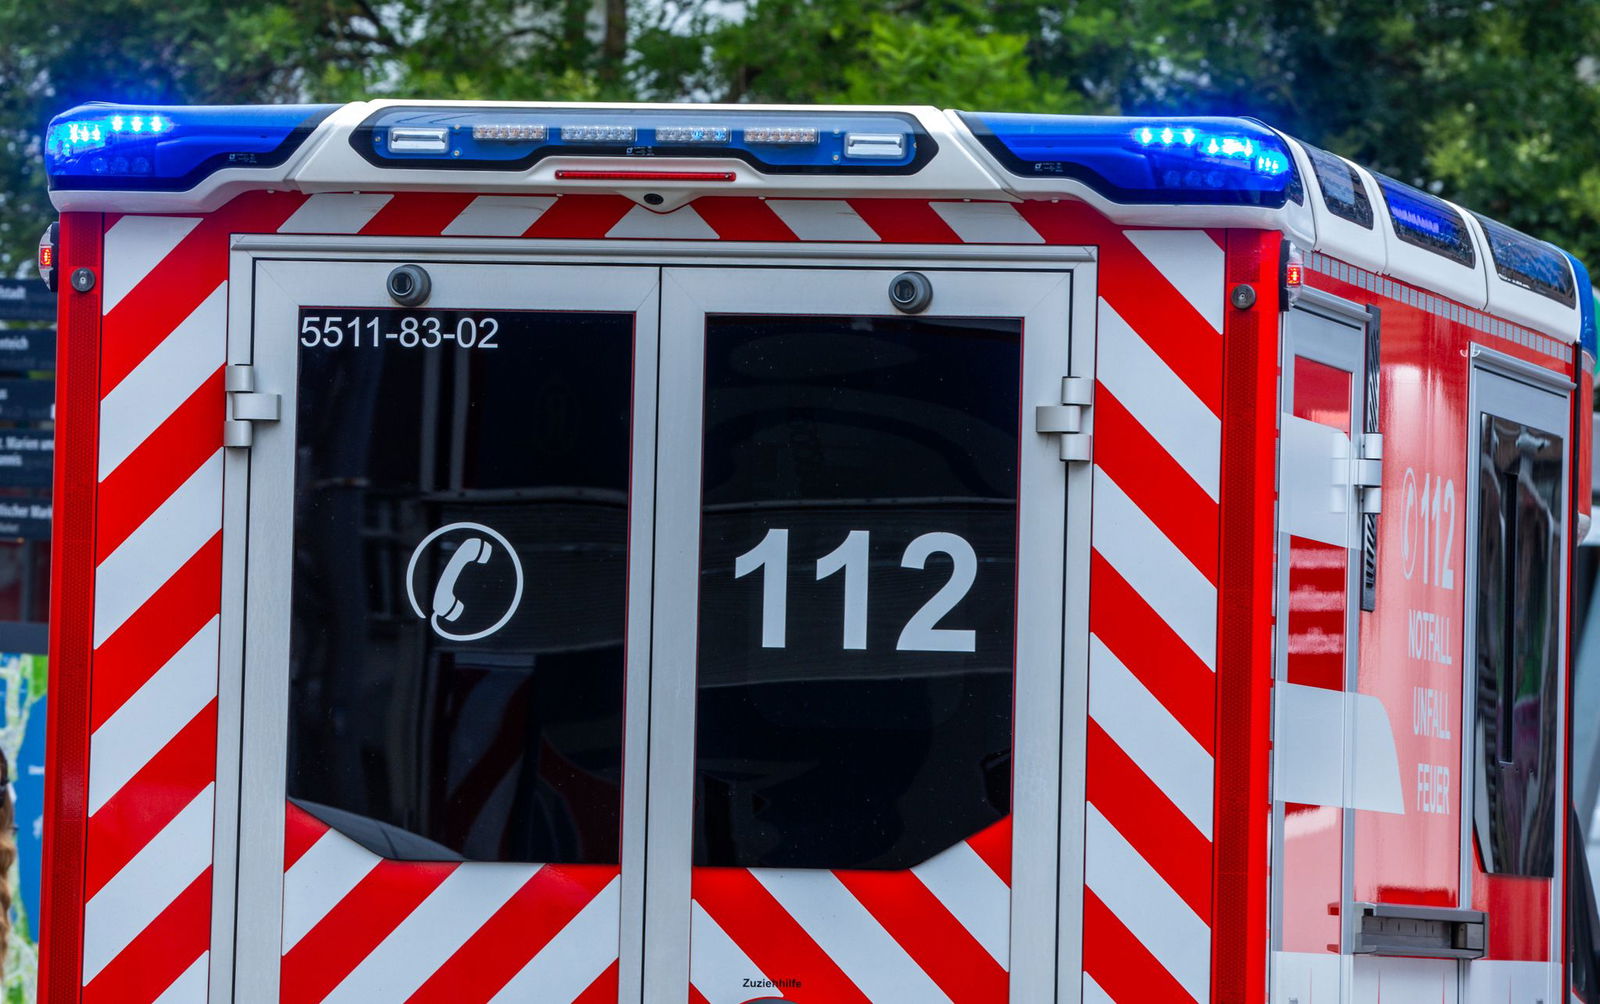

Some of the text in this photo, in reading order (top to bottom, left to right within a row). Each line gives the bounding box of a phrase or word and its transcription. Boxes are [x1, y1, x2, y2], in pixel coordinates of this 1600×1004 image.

[300, 316, 499, 349] 5511-83-02
[1420, 472, 1455, 591] 112
[735, 528, 978, 652] 112
[1408, 609, 1452, 665] NOTFALL
[1413, 687, 1451, 740] UNFALL
[1417, 763, 1450, 815] FEUER
[742, 978, 802, 988] Zuziehhilfe
